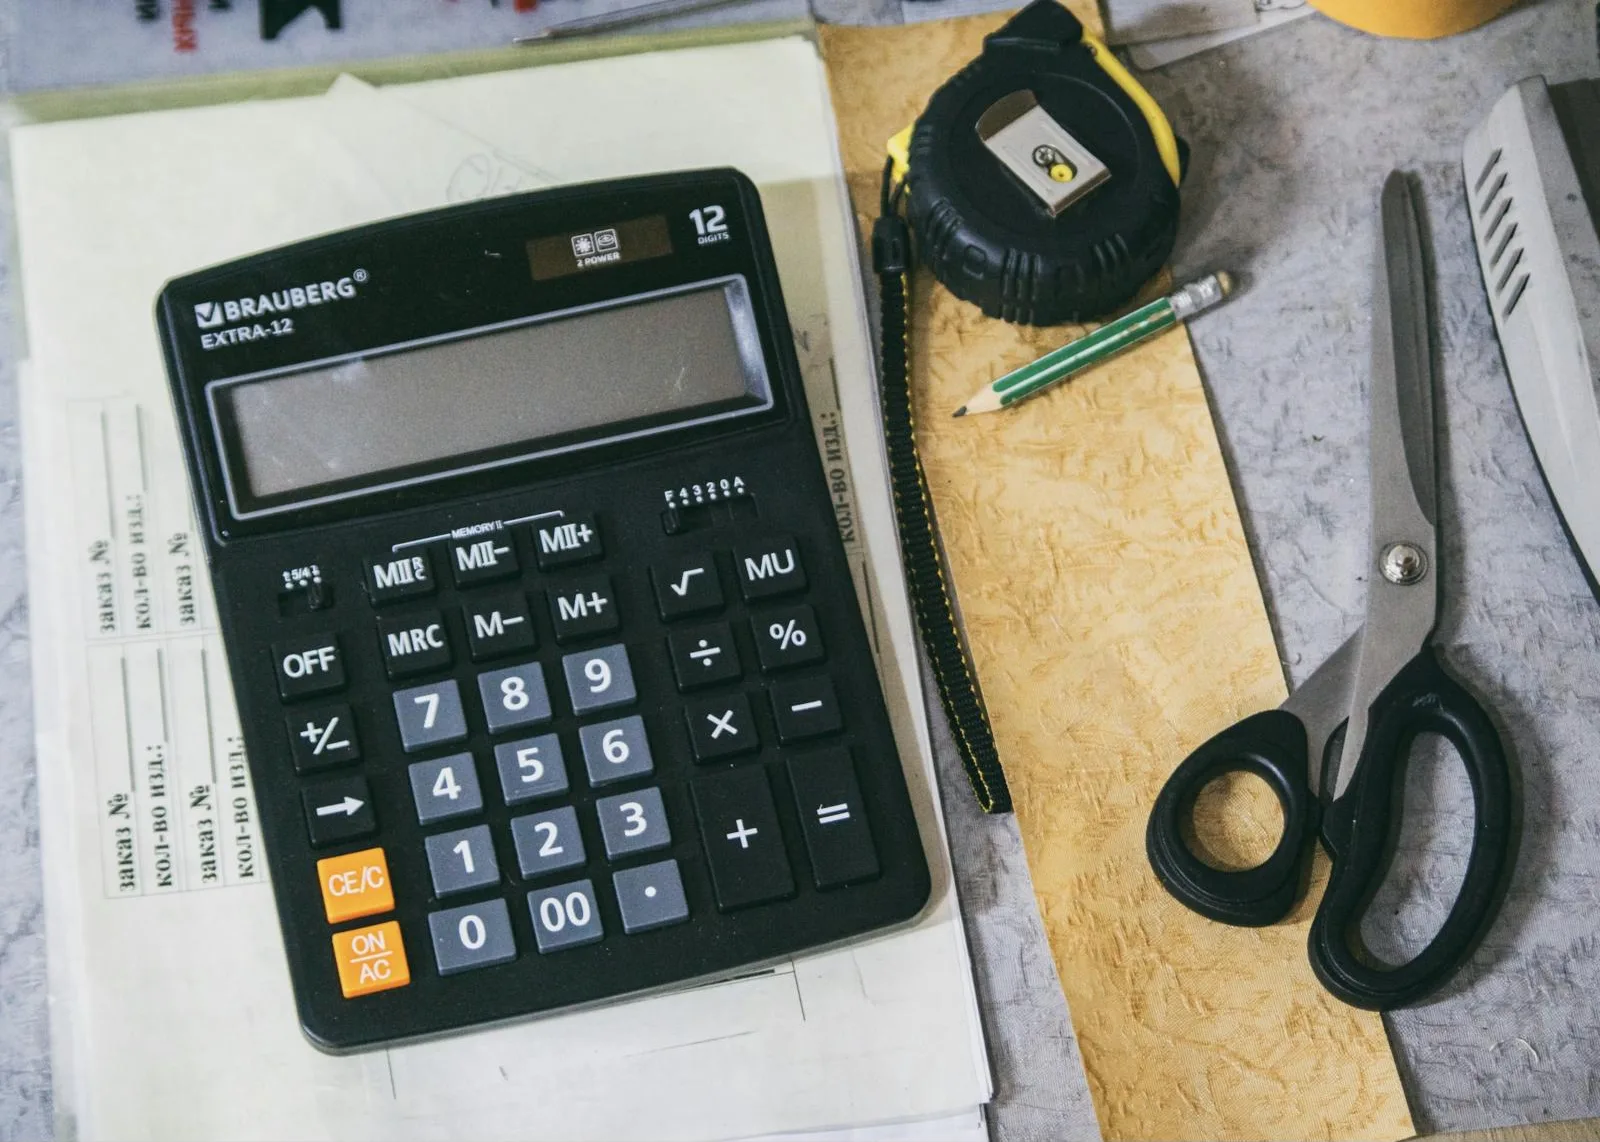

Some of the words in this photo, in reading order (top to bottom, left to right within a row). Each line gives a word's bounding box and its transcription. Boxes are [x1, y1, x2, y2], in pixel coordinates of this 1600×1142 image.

[688, 204, 729, 235] 12
[697, 232, 730, 246] DIGITS
[584, 251, 621, 267] POWER
[200, 317, 295, 350] EXTRA-12
[664, 490, 674, 502] F
[679, 487, 688, 498] 4
[692, 484, 702, 496] 3
[706, 481, 716, 493] 2
[719, 478, 730, 490] 0
[733, 476, 745, 488] A
[451, 521, 495, 539] MEMORY
[744, 549, 795, 581] MU
[557, 591, 608, 621] M+
[387, 624, 444, 657] MRC
[769, 618, 807, 650] %
[283, 646, 335, 678] OFF
[584, 658, 612, 693] 9
[500, 676, 530, 711] 8
[414, 693, 439, 729] 7
[602, 729, 630, 764] 6
[516, 747, 544, 783] 5
[432, 766, 462, 800] 4
[619, 801, 647, 837] 3
[534, 821, 564, 857] 2
[452, 839, 475, 873] 1
[328, 865, 385, 897] CE/C
[540, 891, 591, 932] 00
[351, 932, 387, 953] ON
[458, 914, 486, 950] 0
[358, 958, 392, 984] AC
